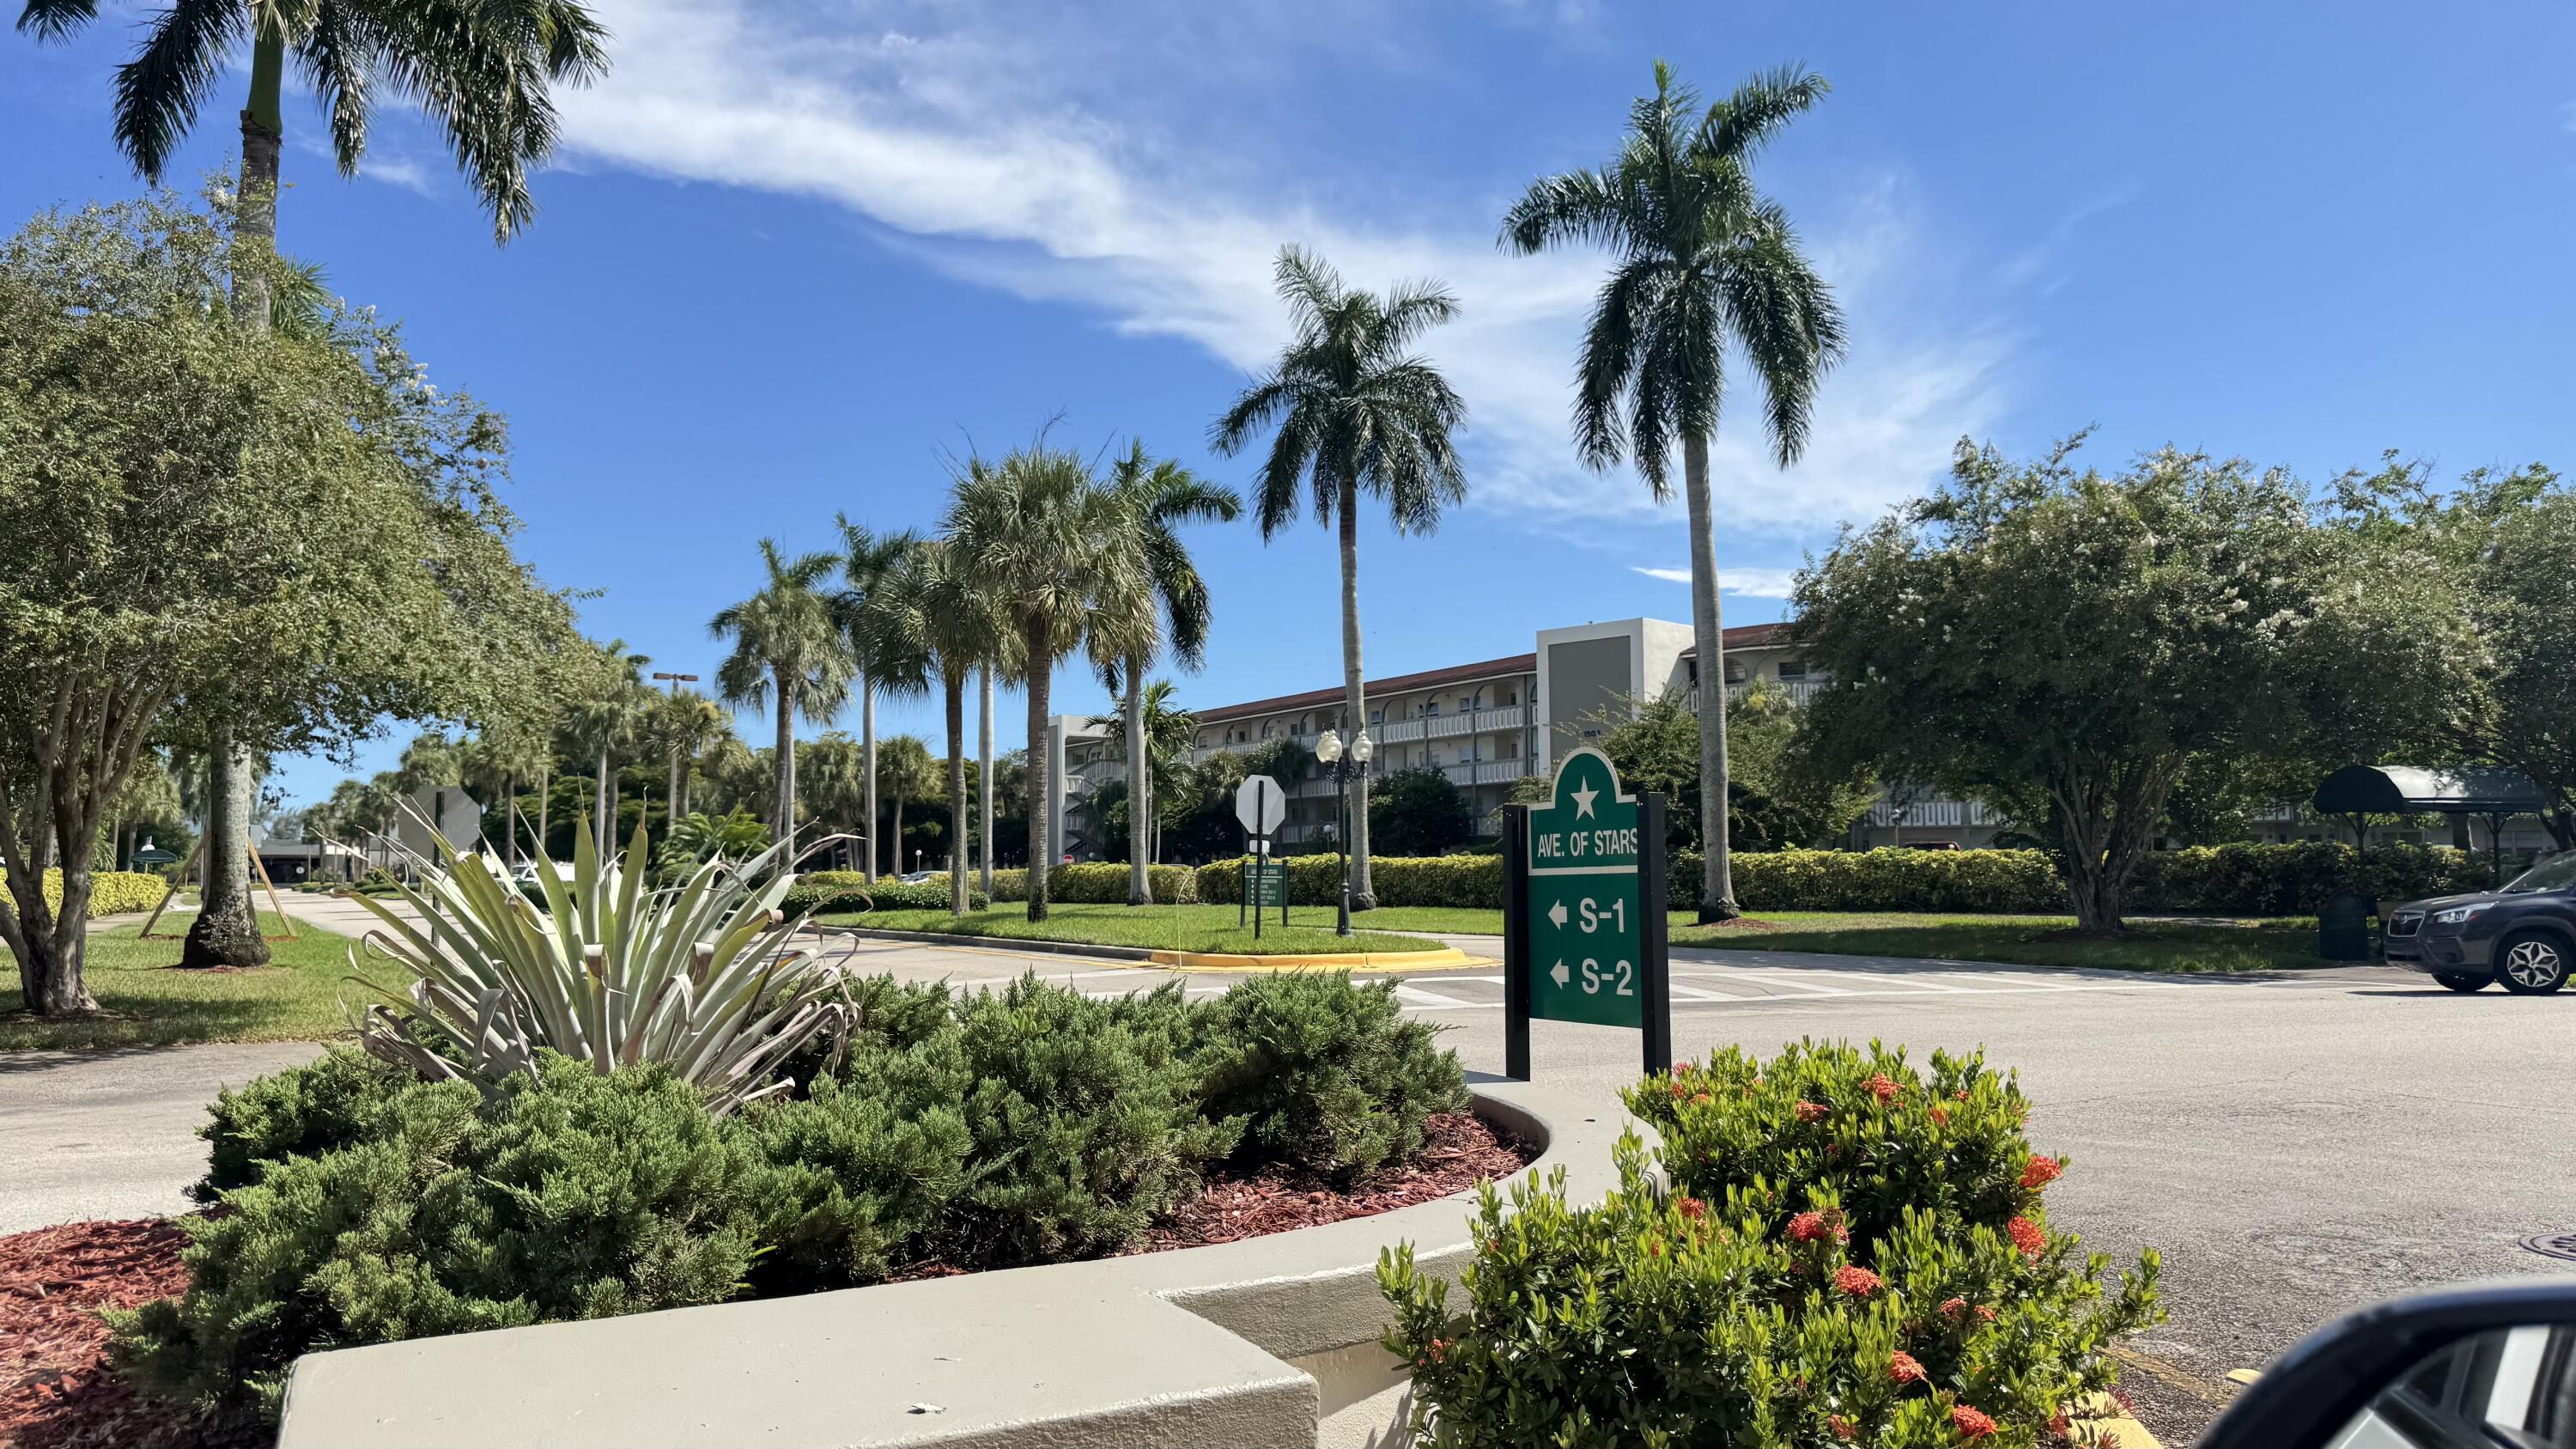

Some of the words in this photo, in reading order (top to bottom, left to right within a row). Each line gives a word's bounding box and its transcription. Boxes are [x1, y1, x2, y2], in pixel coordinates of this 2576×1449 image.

[1537, 833, 1564, 858] AVE.
[1570, 831, 1589, 857] OF
[1594, 827, 1637, 856] STARS
[1579, 897, 1625, 934] S-1
[1581, 958, 1633, 996] S-2
